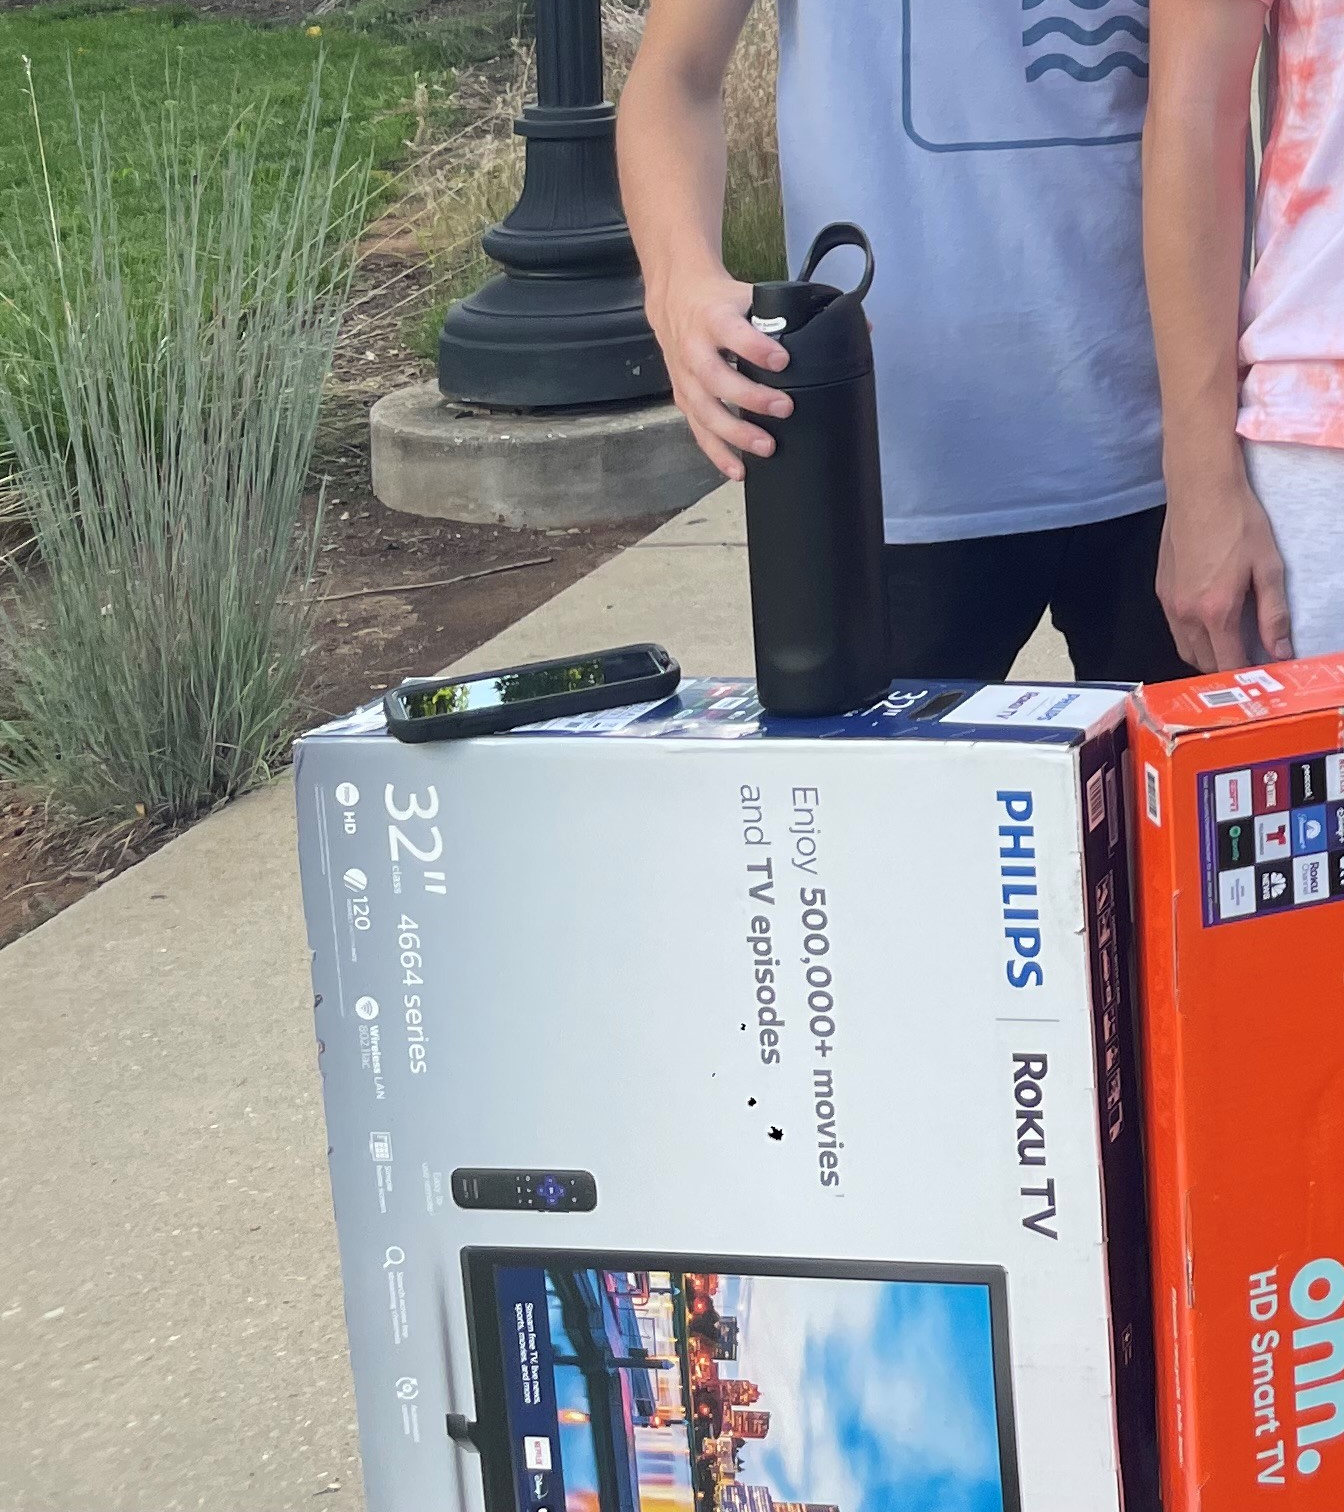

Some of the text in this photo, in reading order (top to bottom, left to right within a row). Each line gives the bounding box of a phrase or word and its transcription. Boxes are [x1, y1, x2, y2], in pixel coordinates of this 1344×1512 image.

[343, 811, 358, 834] HD
[1301, 763, 1313, 801] peacock
[384, 783, 447, 895] 32" class
[352, 896, 371, 931] 120
[740, 784, 786, 1066] and TV episodes
[789, 786, 836, 1059] Enjoy 500,000+
[996, 790, 1044, 989] PHILIPS
[397, 913, 431, 1075] 4664 series
[369, 1025, 386, 1100] Wireless LAN
[1019, 1176, 1059, 1242] TV
[524, 1303, 534, 1331] Stream
[1249, 1267, 1285, 1485] HD Smart TV
